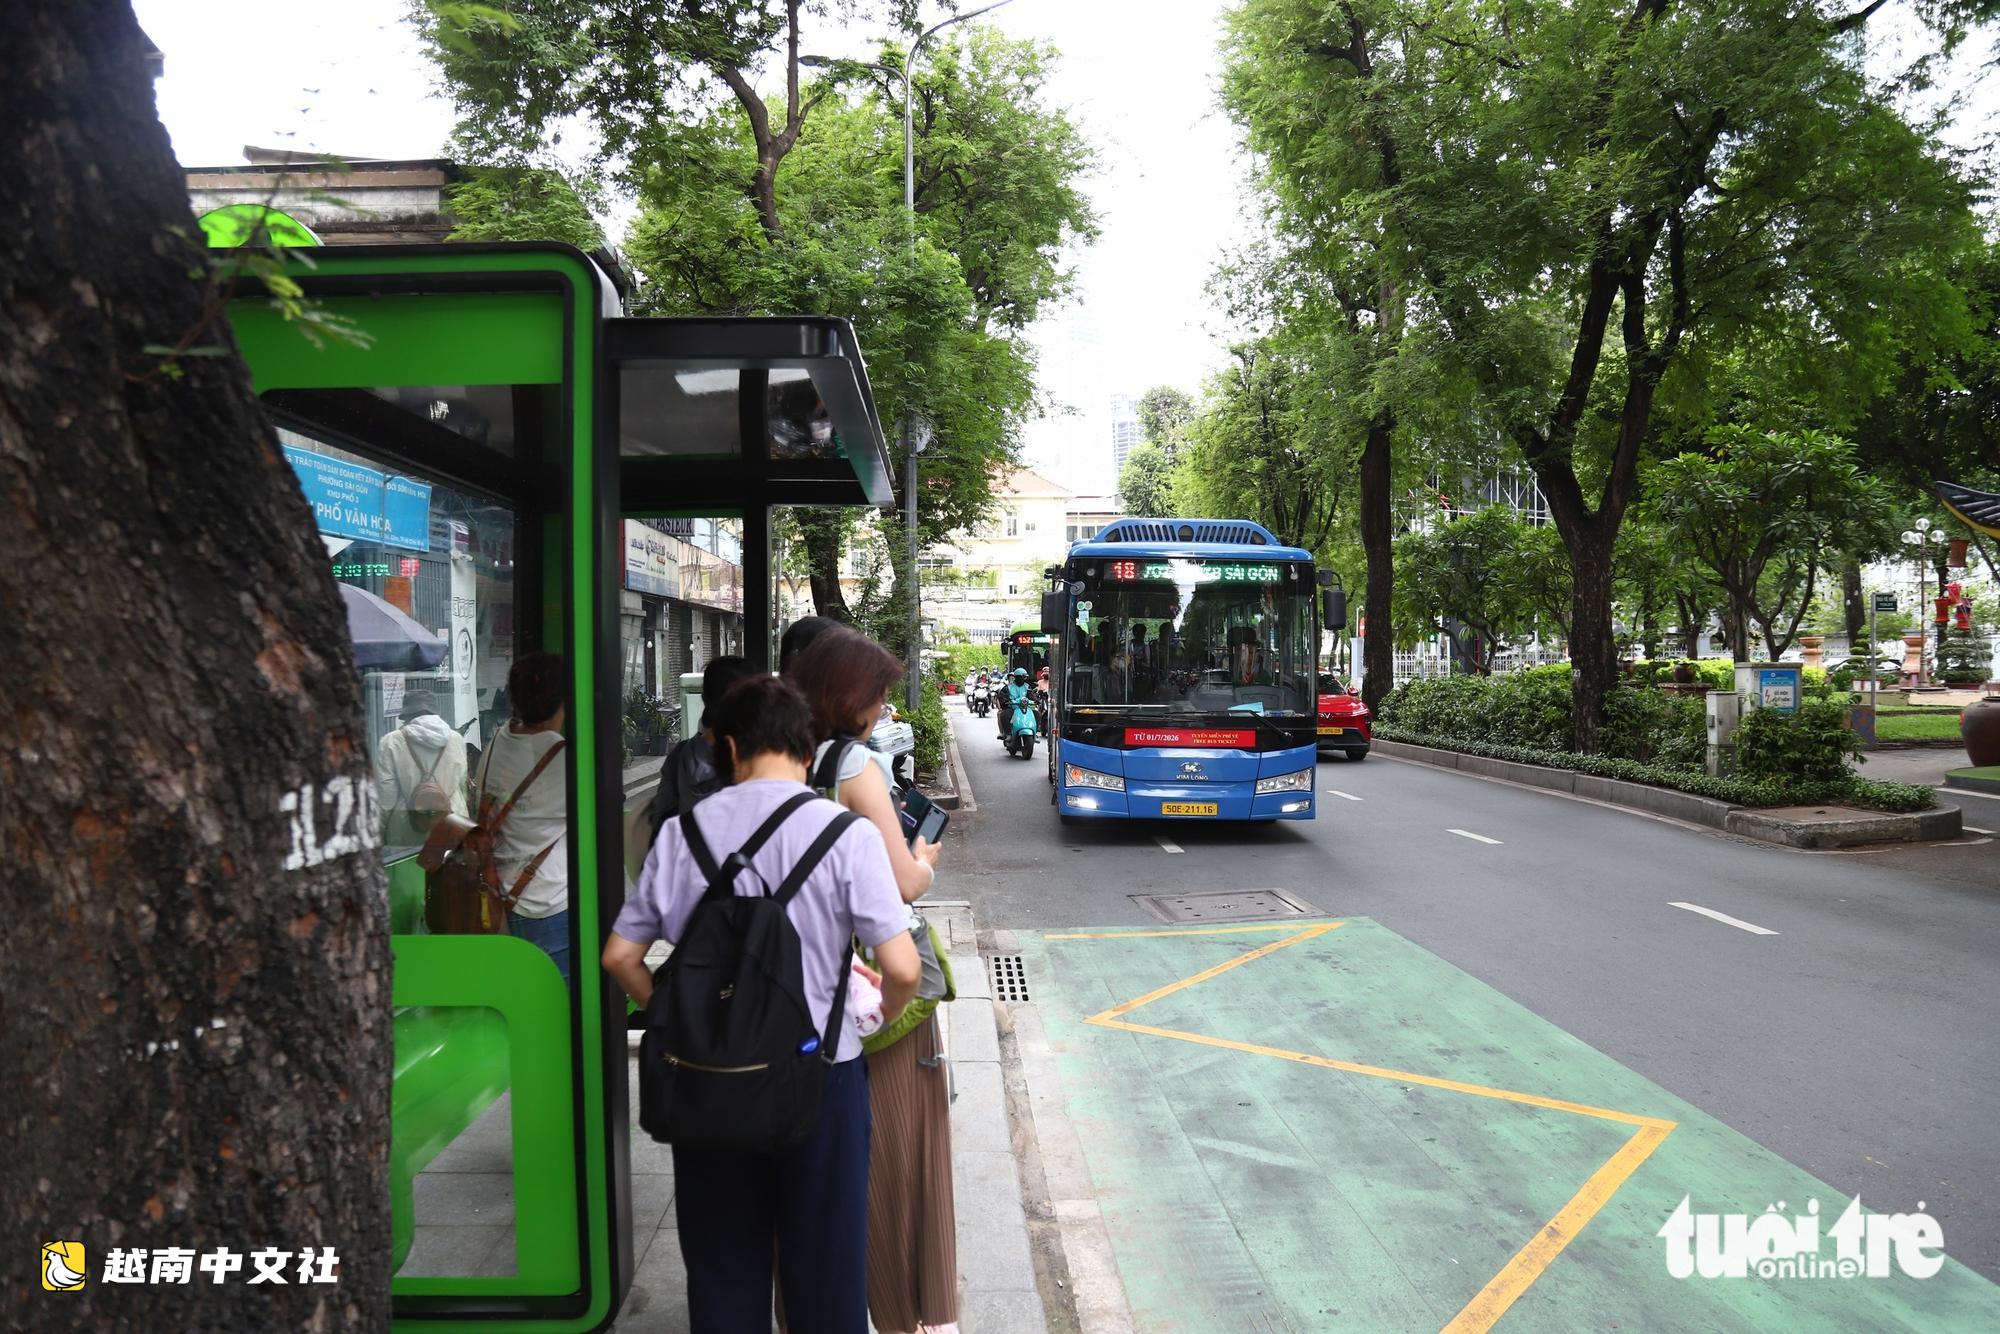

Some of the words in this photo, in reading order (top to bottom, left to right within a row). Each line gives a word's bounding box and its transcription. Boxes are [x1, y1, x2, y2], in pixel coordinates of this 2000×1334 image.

[317, 501, 342, 521] PHỐ
[345, 507, 368, 527] VĂN
[1114, 562, 1135, 579] 18
[1018, 636, 1031, 644] 152
[1146, 733, 1179, 741] 01/7/2026
[1166, 804, 1213, 814] 50E-211.16
